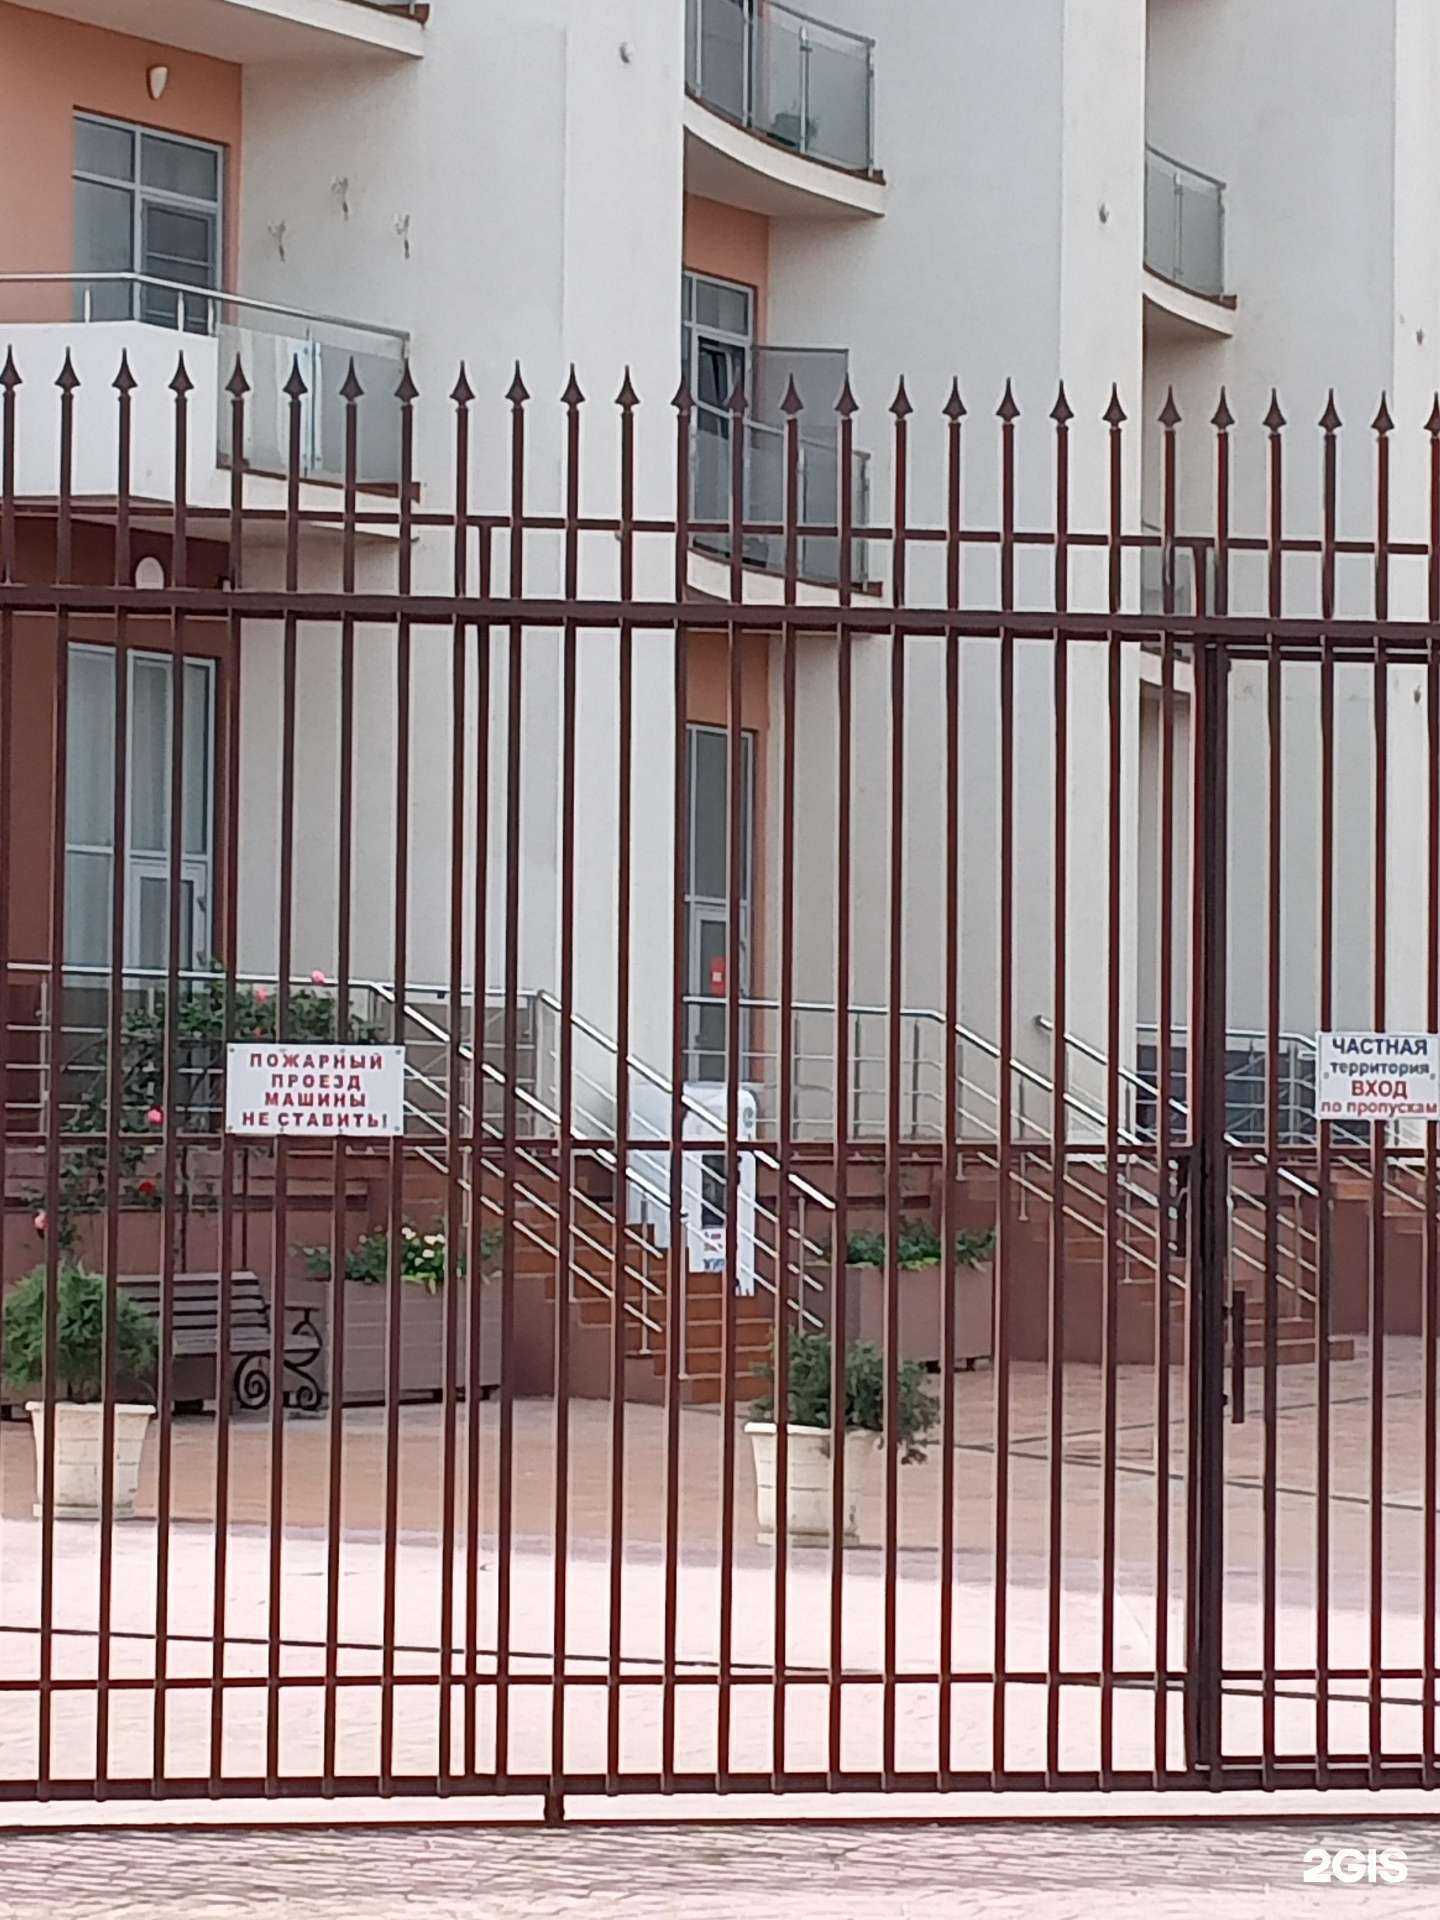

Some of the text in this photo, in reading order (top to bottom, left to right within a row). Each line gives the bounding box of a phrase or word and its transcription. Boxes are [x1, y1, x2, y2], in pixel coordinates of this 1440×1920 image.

[1332, 1038, 1428, 1055] ЧАСТНАЯ
[250, 1052, 383, 1069] ПОЖАРНЫЙ
[1330, 1062, 1430, 1077] территория
[271, 1074, 361, 1091] ПРОЕЗД
[1351, 1080, 1408, 1099] ВХОД
[264, 1092, 366, 1107] МАШИНЫ
[1321, 1101, 1438, 1118] по пропускам
[242, 1112, 388, 1128] НЕ СТАВИТЬ!
